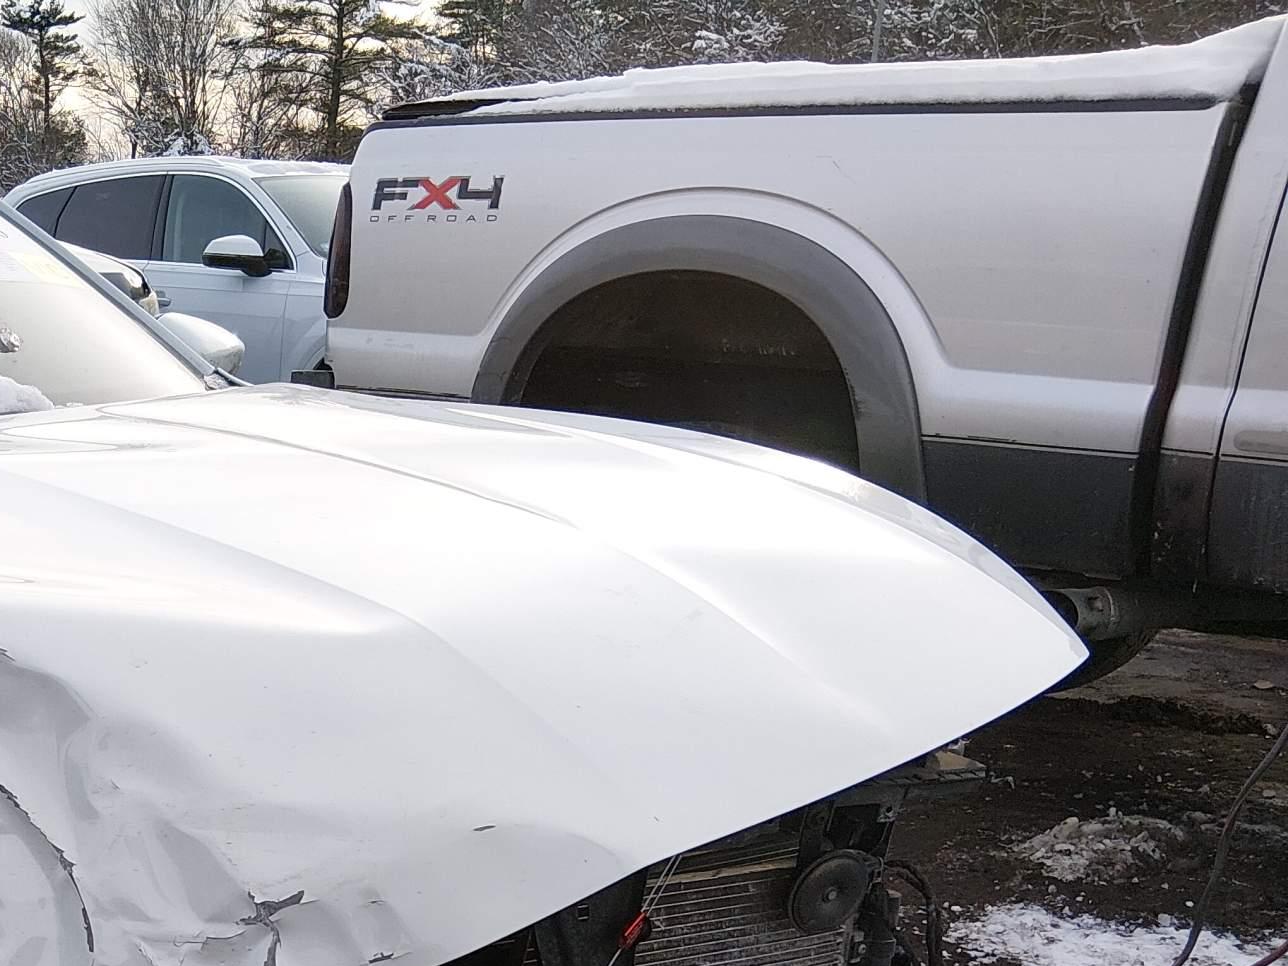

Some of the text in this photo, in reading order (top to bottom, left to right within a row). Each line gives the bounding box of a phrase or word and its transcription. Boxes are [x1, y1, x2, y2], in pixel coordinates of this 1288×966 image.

[371, 175, 506, 211] FX4
[369, 214, 498, 223] OFF ROAD
